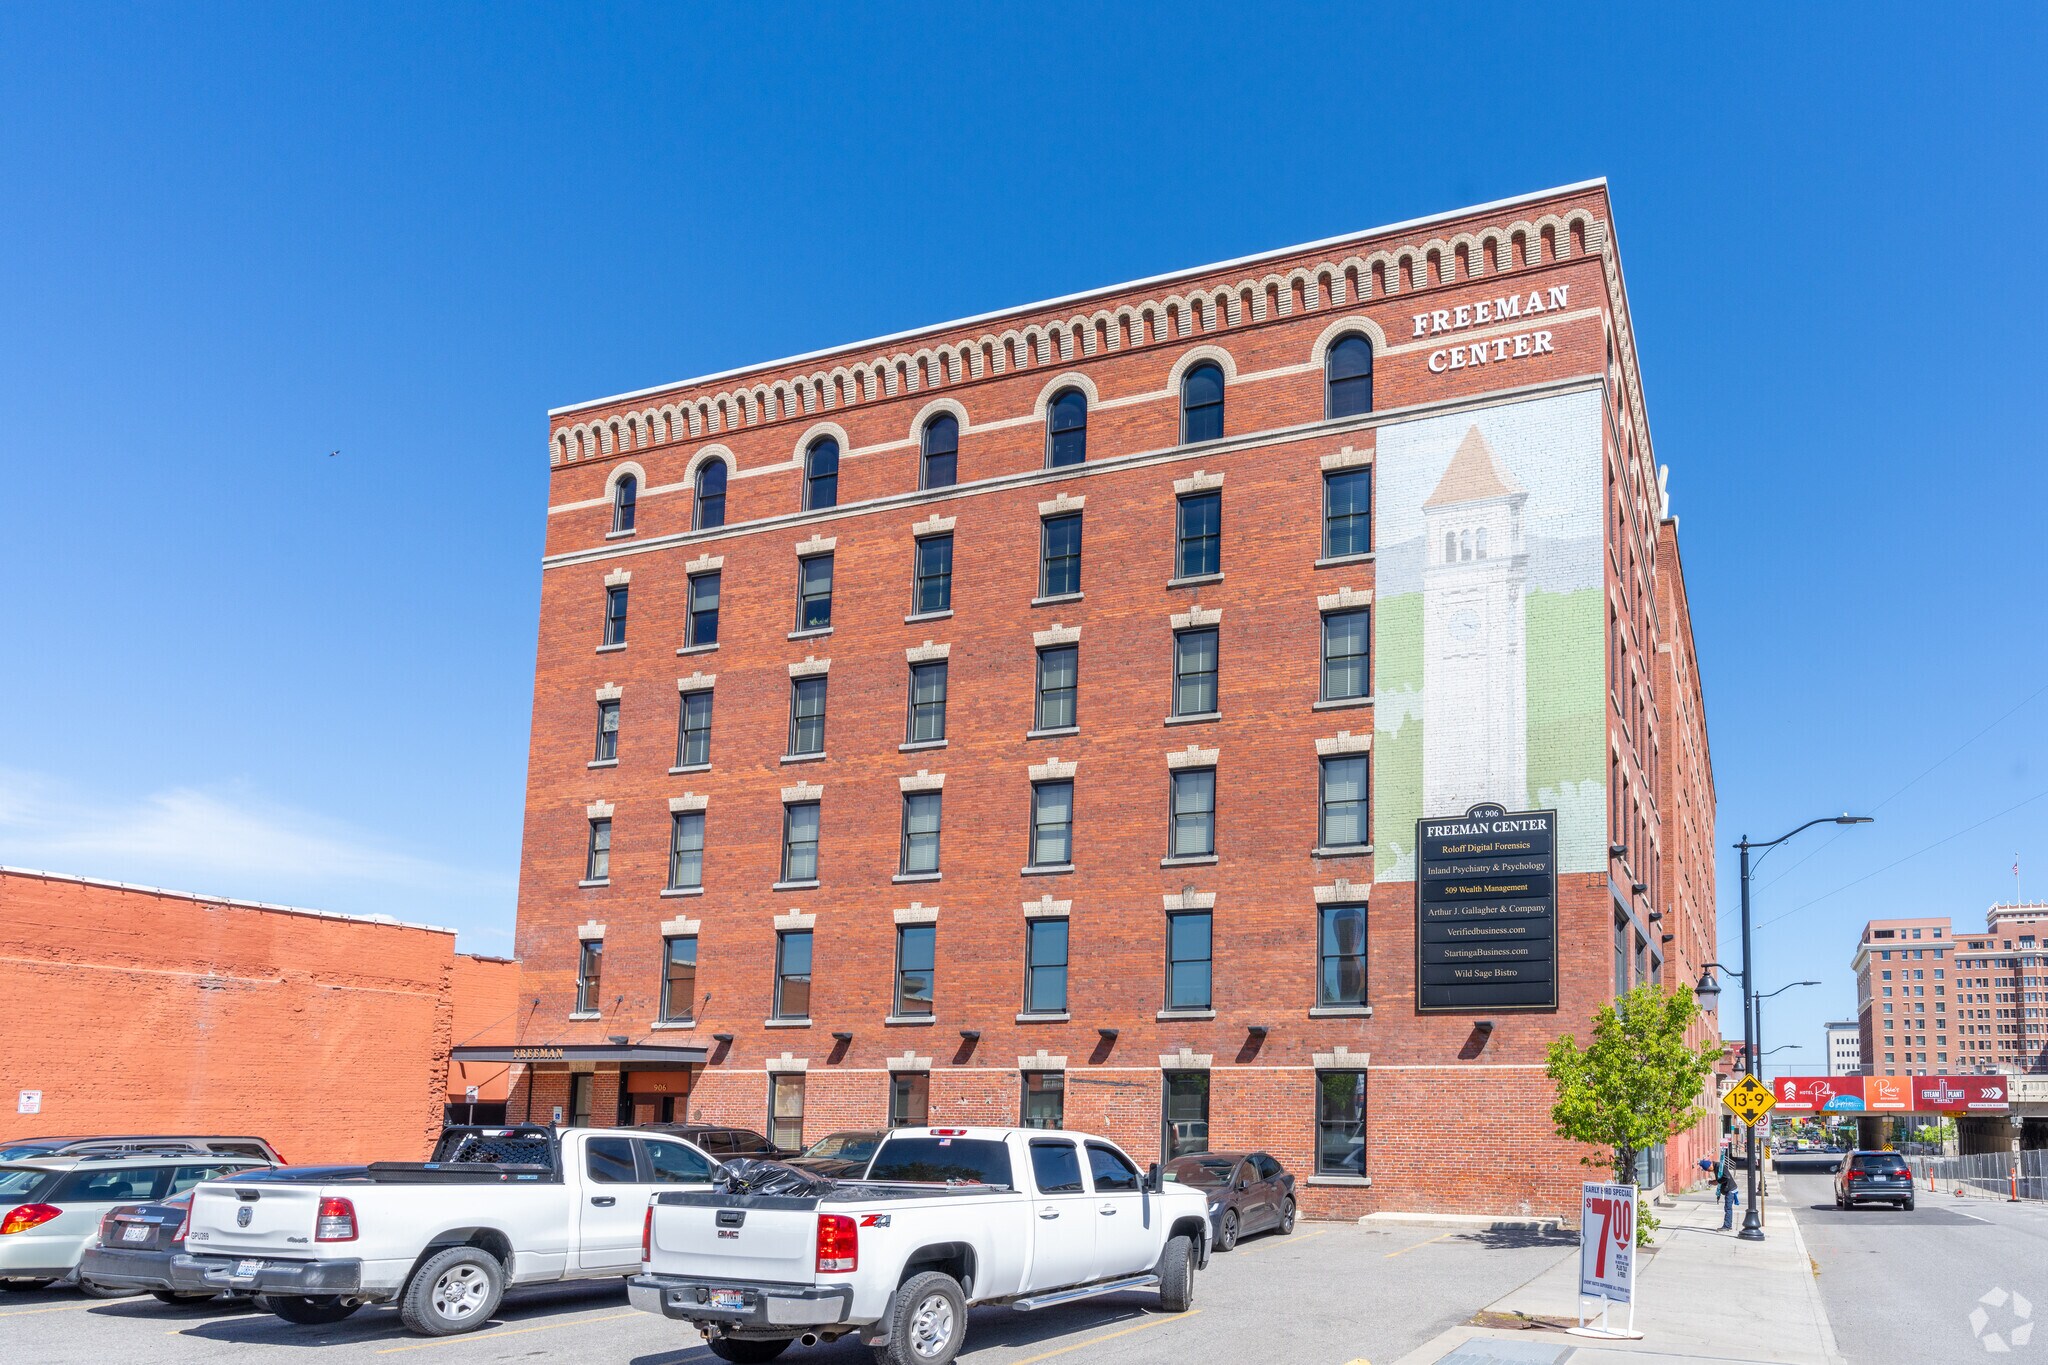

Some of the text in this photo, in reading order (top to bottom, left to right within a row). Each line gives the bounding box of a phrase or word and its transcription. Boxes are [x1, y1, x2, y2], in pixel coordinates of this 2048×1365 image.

[1412, 284, 1570, 337] FREEMAN
[1428, 330, 1554, 372] CENTER
[1474, 809, 1498, 818] W. 906
[1426, 819, 1547, 837] FREEMAN CENTER
[1442, 841, 1531, 854] Roloff Digital Forensics
[1428, 862, 1546, 875] Inland Psychiatry & Psychology
[1445, 883, 1528, 895] 509 Wealth Management
[1428, 904, 1546, 916] Arthur J. Gallagher & Company
[1447, 926, 1526, 936] Verifiedbusiness.com
[1444, 947, 1528, 958] StartingaBusiness.com
[1454, 968, 1518, 978] Wild Sage Bistro
[513, 1048, 564, 1059] FREEMAN
[1808, 1080, 1837, 1102] Ruby
[1923, 1090, 1963, 1098] STEAM PLANT
[1585, 1185, 1599, 1194] EARLY
[1612, 1188, 1633, 1198] SPECIAL
[717, 1230, 740, 1239] GMC
